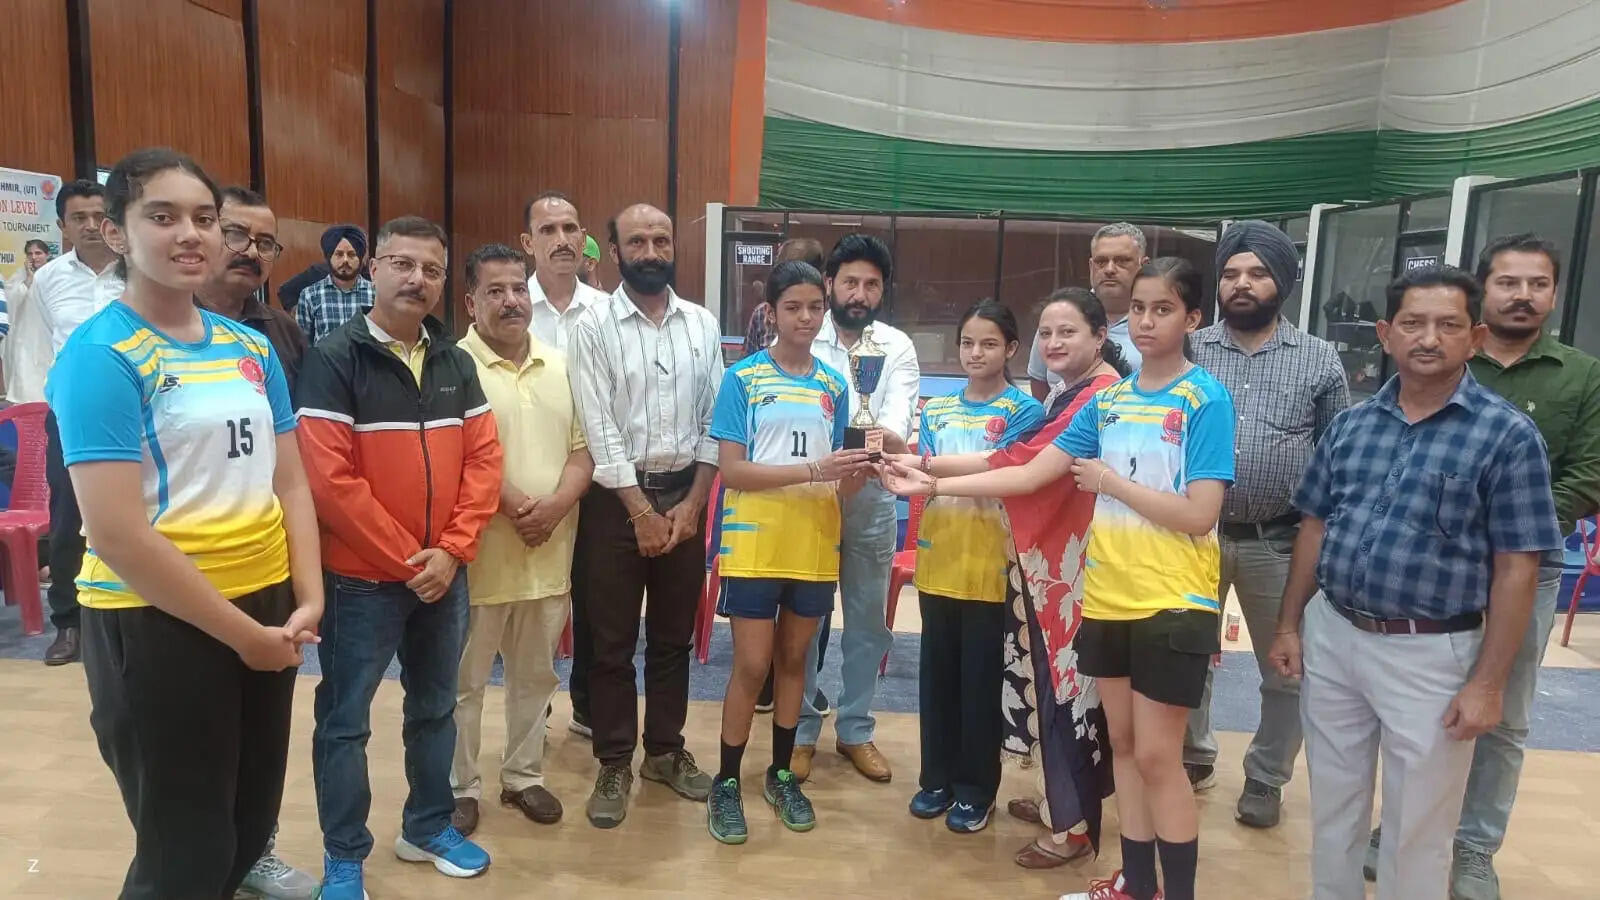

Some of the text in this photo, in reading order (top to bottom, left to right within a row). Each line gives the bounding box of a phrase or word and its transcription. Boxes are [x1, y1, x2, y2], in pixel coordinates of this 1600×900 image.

[23, 184, 37, 196] (UT)
[10, 200, 38, 215] LEVEL
[2, 221, 51, 232] TOURNAMENT
[737, 246, 771, 255] SHOUTING
[742, 254, 766, 264] RANGE
[227, 417, 254, 459] 15
[791, 430, 808, 457] 11
